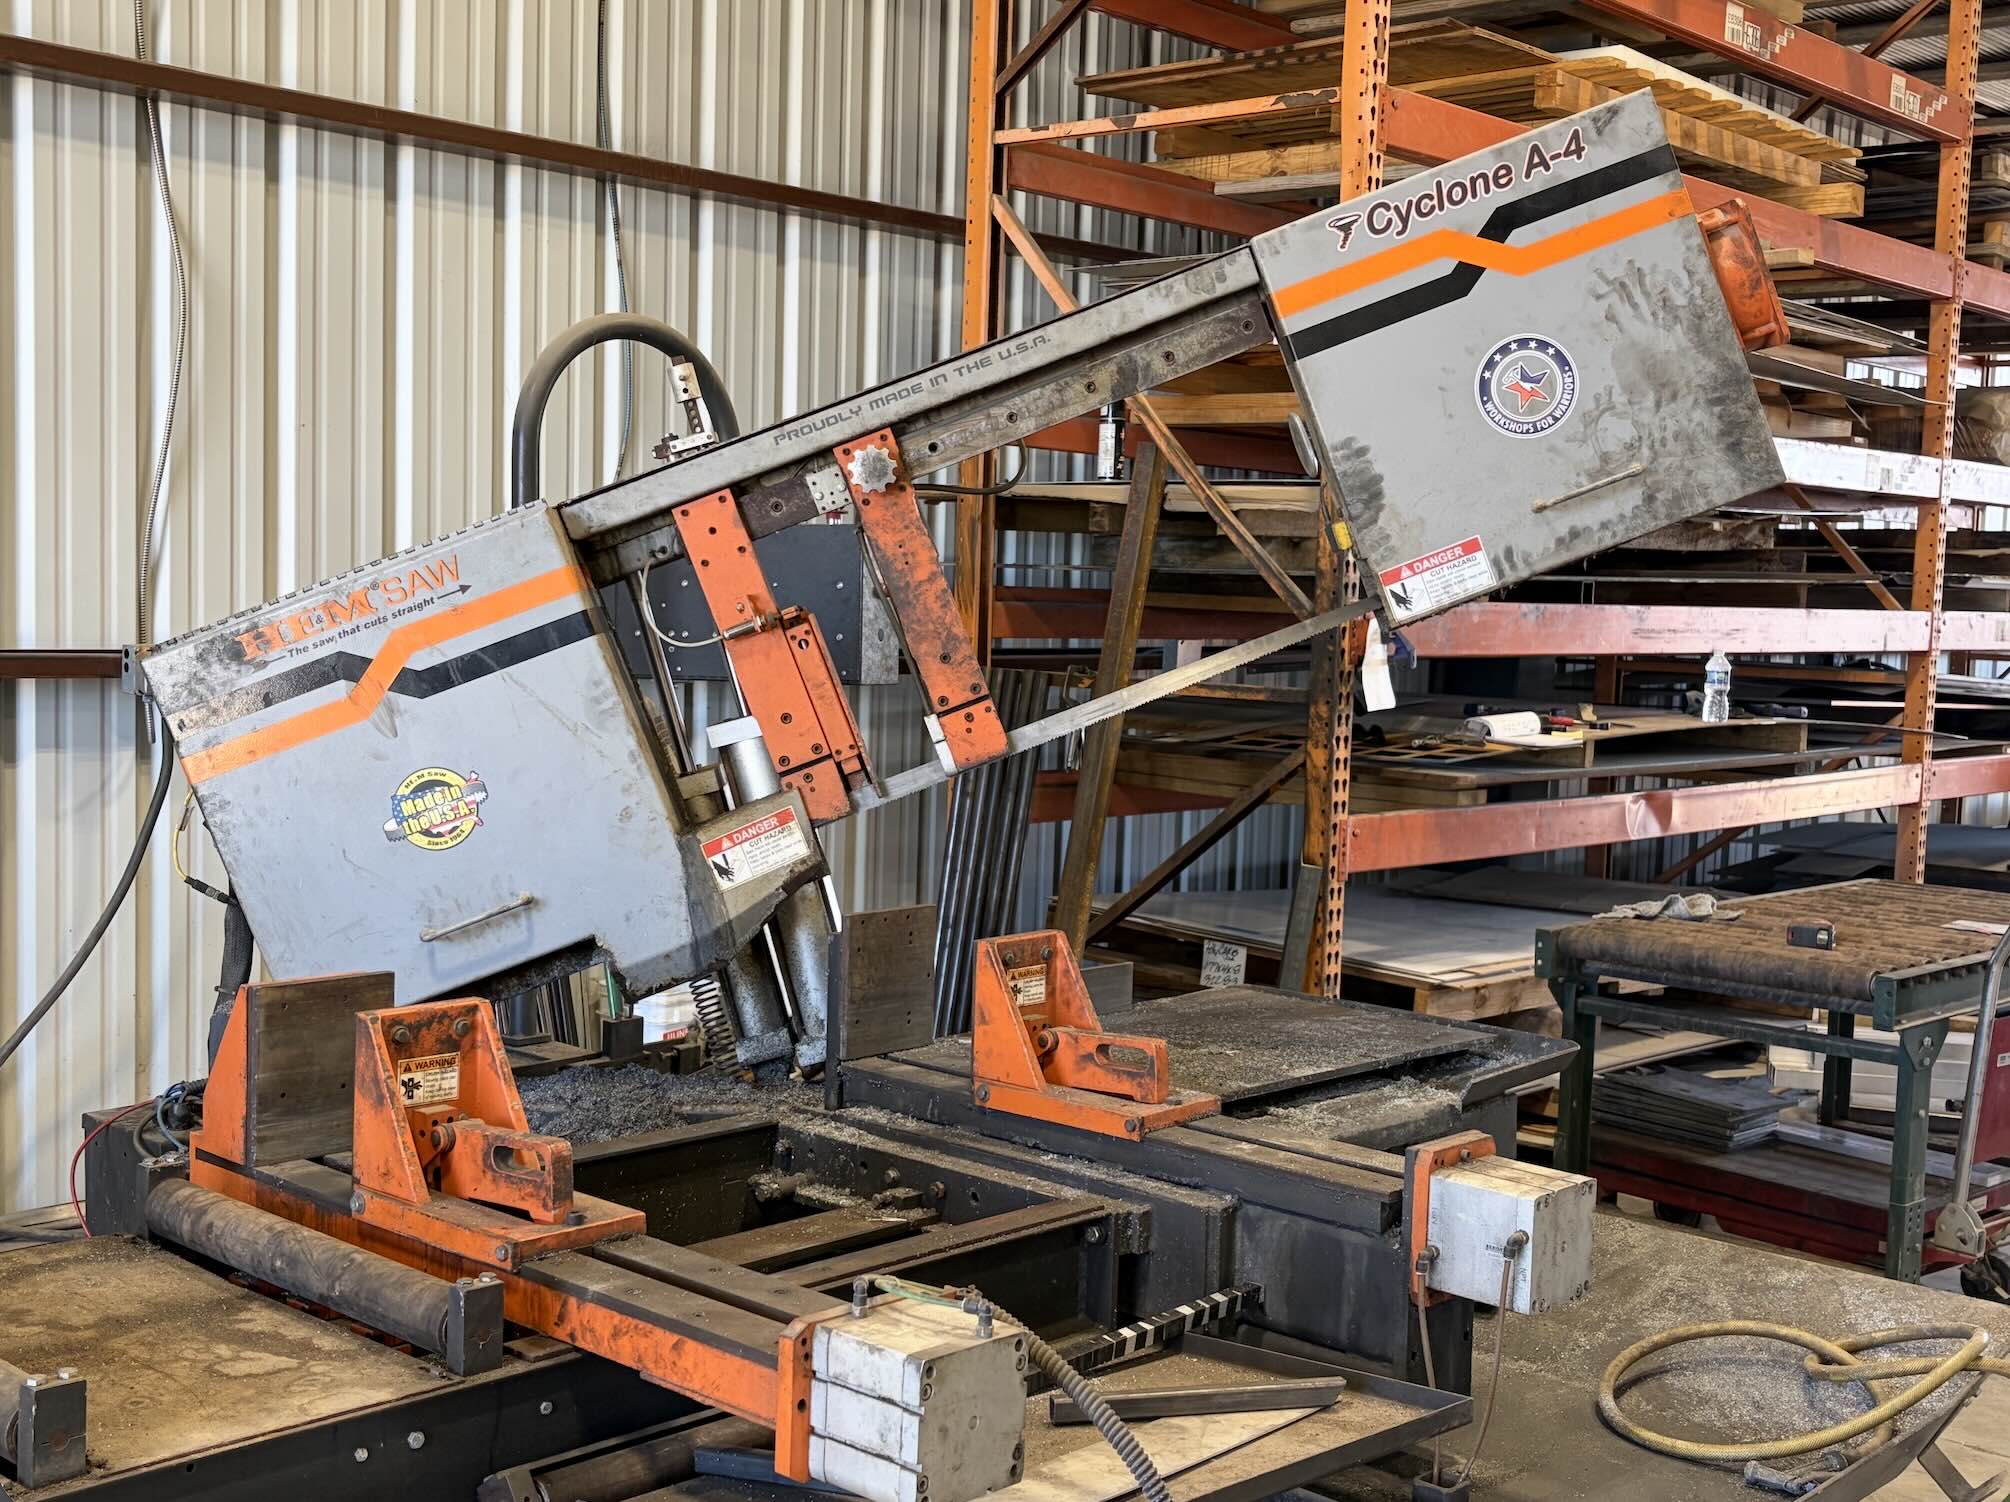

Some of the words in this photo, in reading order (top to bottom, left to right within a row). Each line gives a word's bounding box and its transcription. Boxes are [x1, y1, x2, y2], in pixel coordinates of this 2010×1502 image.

[1366, 163, 1513, 237] Cyclone
[1524, 128, 1586, 180] A-4
[774, 405, 862, 446] PROUDLY
[869, 382, 924, 411] MADE
[929, 373, 949, 388] IN
[953, 356, 993, 378] THE
[998, 334, 1051, 360] U.S.A.
[1484, 401, 1534, 433] WORKSHOPS
[1536, 416, 1555, 431] FOR
[1552, 371, 1574, 418] WARRIORS
[1413, 546, 1465, 573] DANGER
[1430, 567, 1446, 577] CUT
[1448, 555, 1477, 572] HAZARD
[378, 554, 460, 606] SAW
[287, 643, 310, 658] The
[338, 623, 361, 640] that
[363, 614, 389, 629] cuts
[391, 596, 435, 620] straight
[400, 791, 445, 817] Made
[402, 814, 431, 835] the
[429, 800, 475, 825] U.S.A.
[732, 816, 780, 844] DANGER
[749, 838, 763, 848] CUT
[764, 825, 792, 842] HAZARD
[1017, 967, 1044, 978] WARNING
[415, 1057, 457, 1070] WARNING
